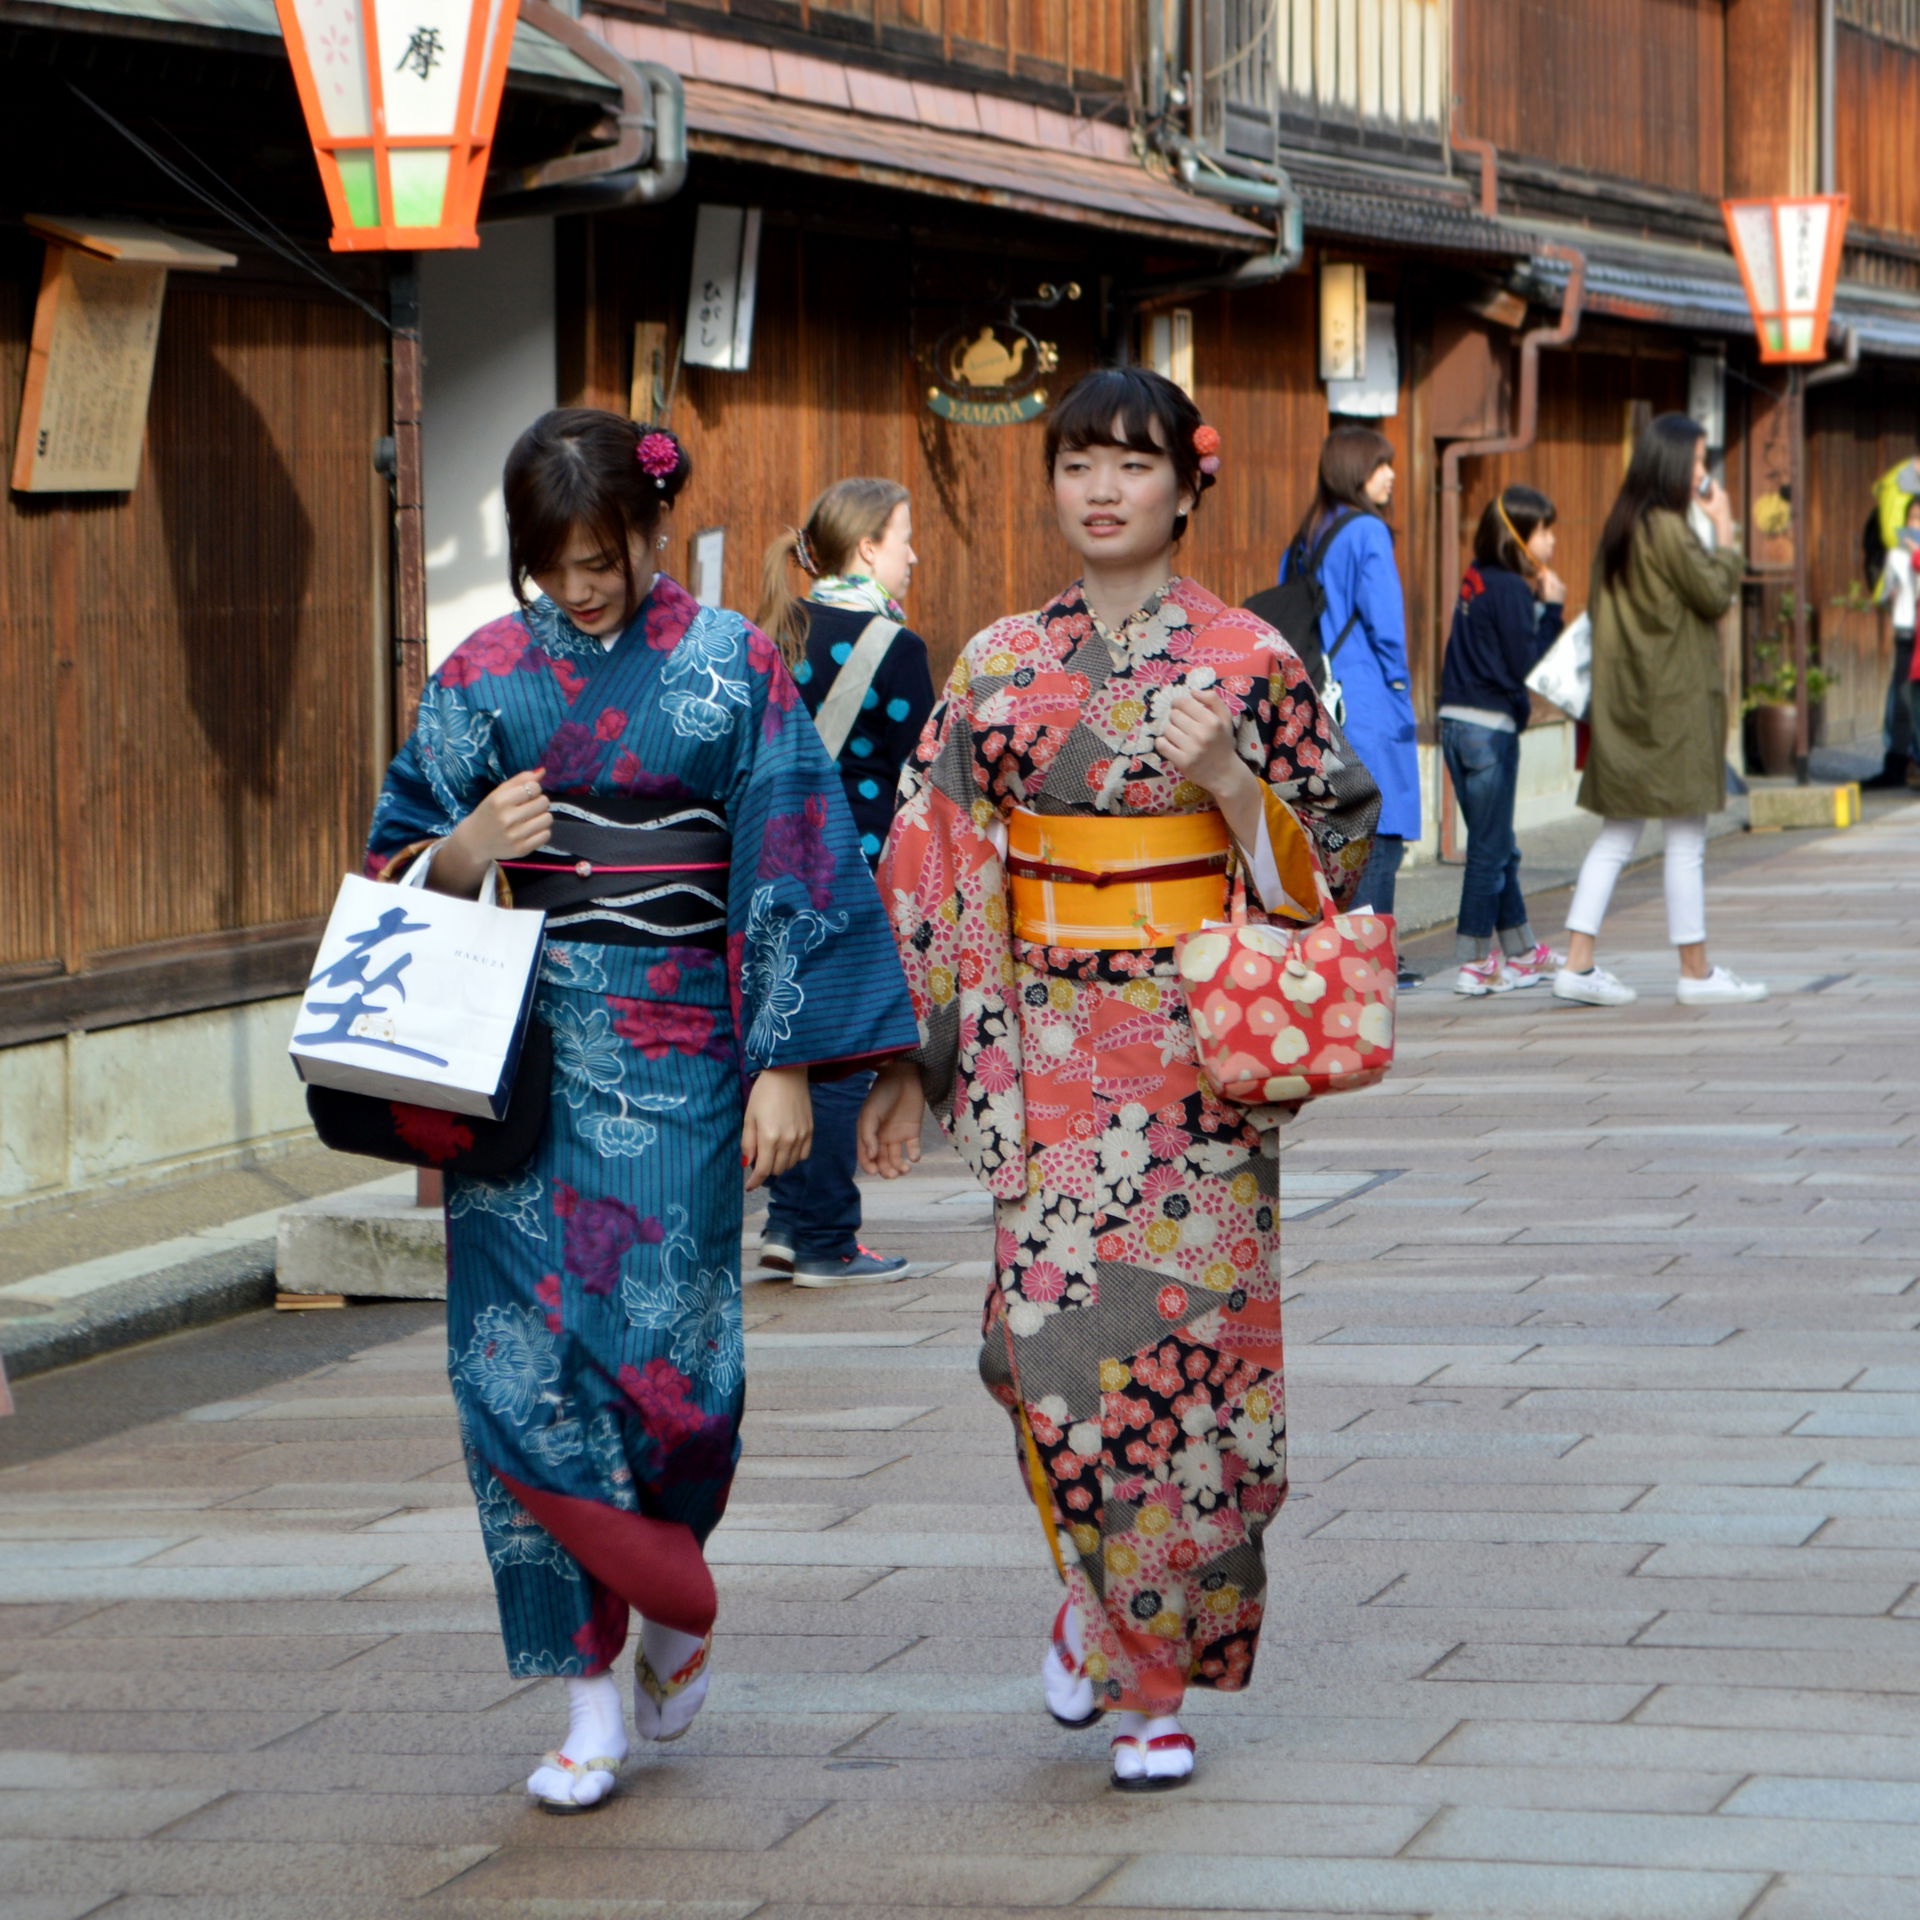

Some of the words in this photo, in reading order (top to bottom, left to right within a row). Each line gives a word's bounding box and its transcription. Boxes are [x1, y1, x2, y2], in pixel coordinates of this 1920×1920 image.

[395, 26, 443, 80] 摩
[700, 279, 722, 347] ひがし
[948, 400, 1024, 425] YAMAYA
[453, 949, 505, 969] HAKUZA
